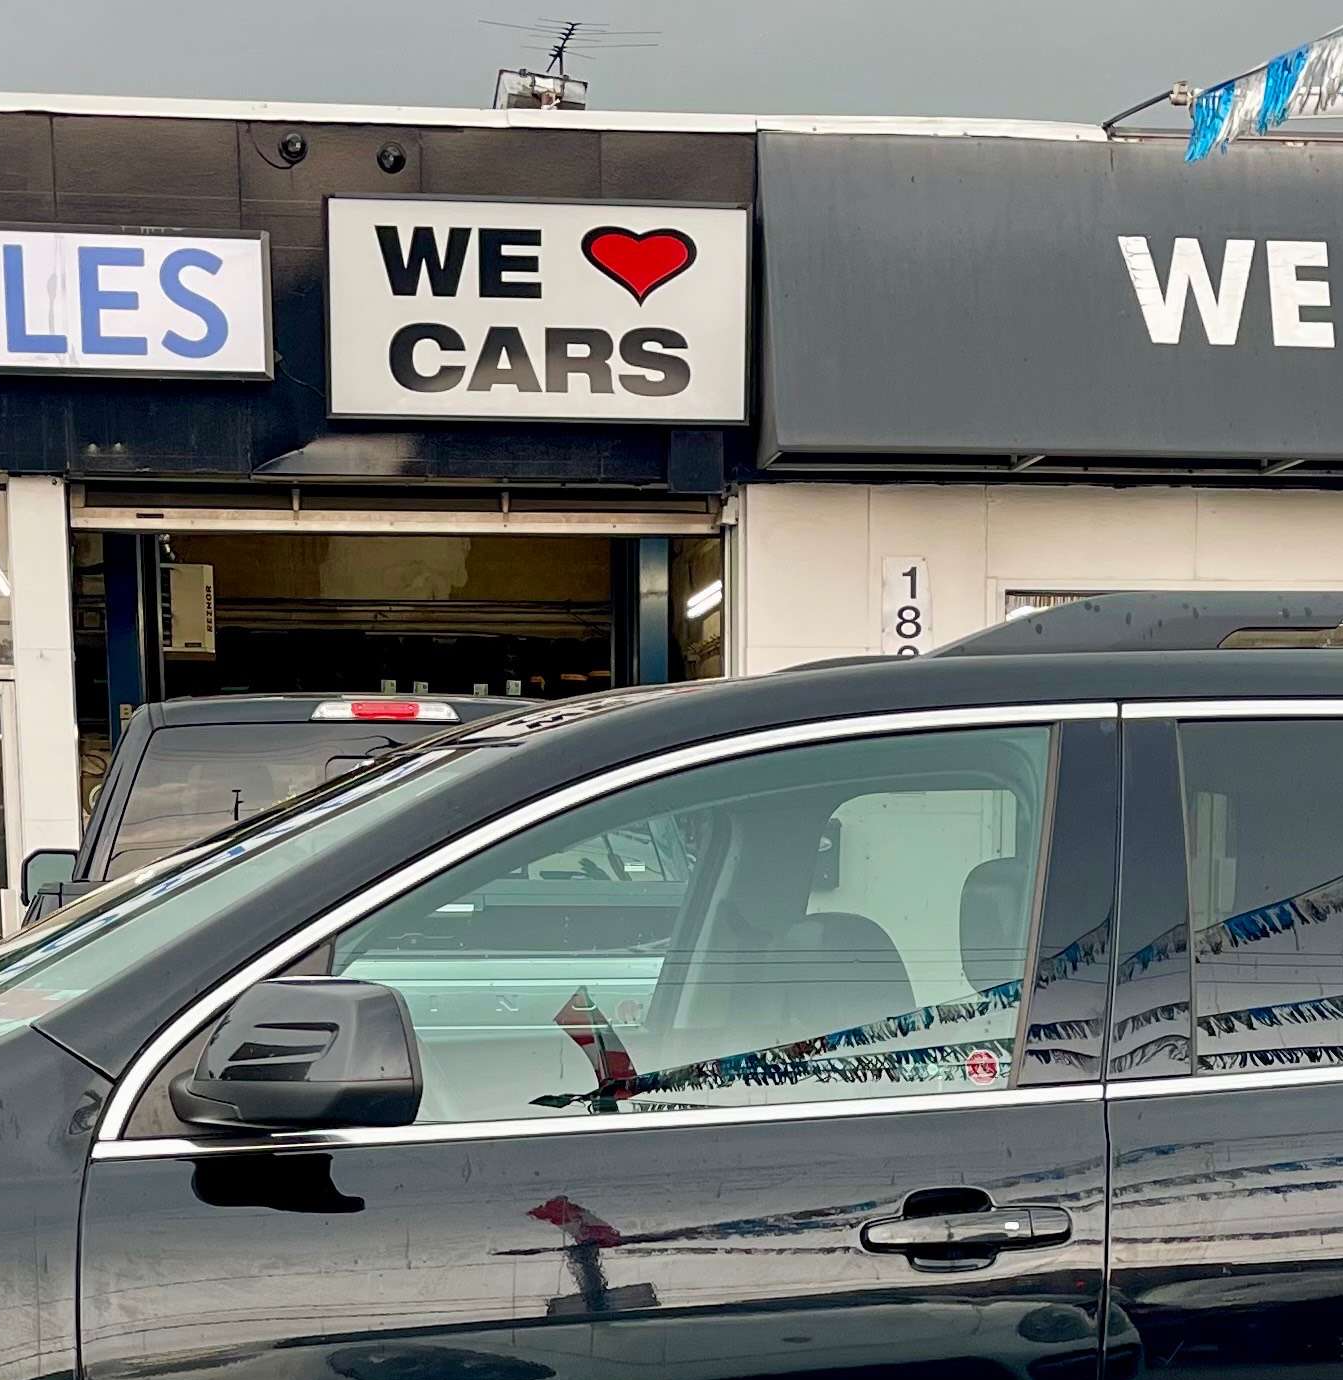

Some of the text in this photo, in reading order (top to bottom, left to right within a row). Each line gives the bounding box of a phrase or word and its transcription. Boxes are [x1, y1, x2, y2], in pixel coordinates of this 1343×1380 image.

[374, 224, 543, 299] WE
[1118, 235, 1336, 349] WE
[388, 321, 692, 398] CARS
